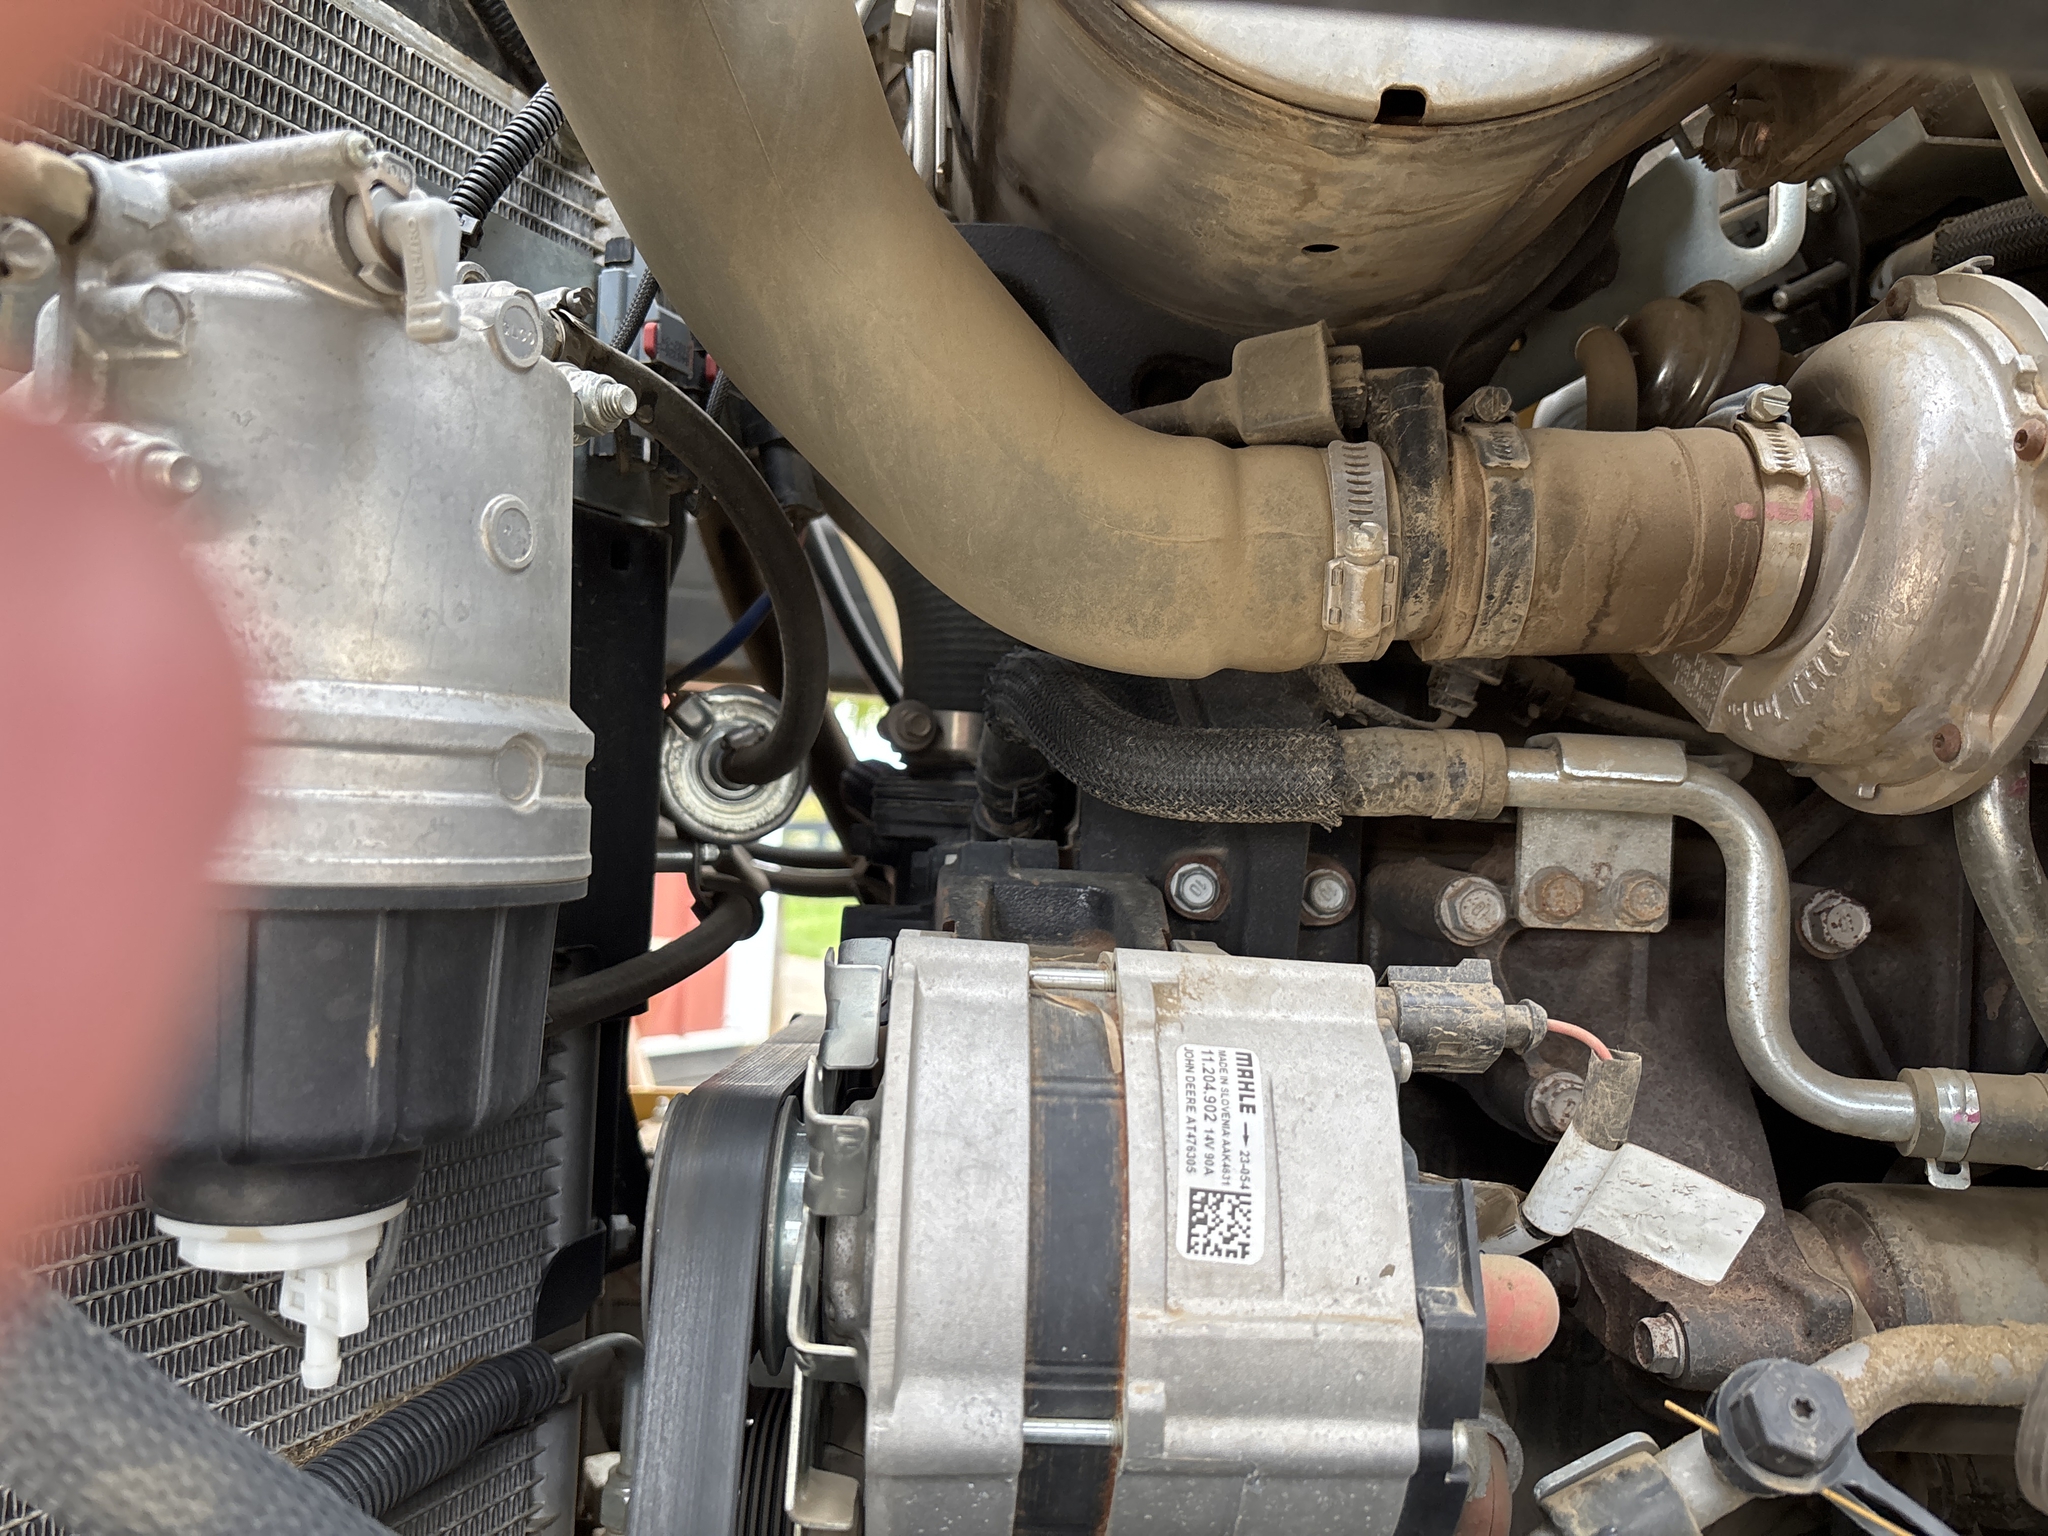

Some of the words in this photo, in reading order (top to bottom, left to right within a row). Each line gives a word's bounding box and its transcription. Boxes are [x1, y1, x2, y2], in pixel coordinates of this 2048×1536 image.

[1184, 1046, 1195, 1074] JOHN
[1218, 1049, 1229, 1074] MADE
[1185, 1075, 1197, 1113] DEERE
[1201, 1049, 1218, 1123] 11.204.902
[1219, 1075, 1229, 1085] IN
[1235, 1051, 1257, 1115] MAHLE
[1220, 1087, 1231, 1137] SLOVENIA
[1185, 1115, 1197, 1175] AT476305
[1203, 1128, 1216, 1151] 14V
[1203, 1152, 1215, 1176] 90A
[1239, 1149, 1251, 1190] 23-054
